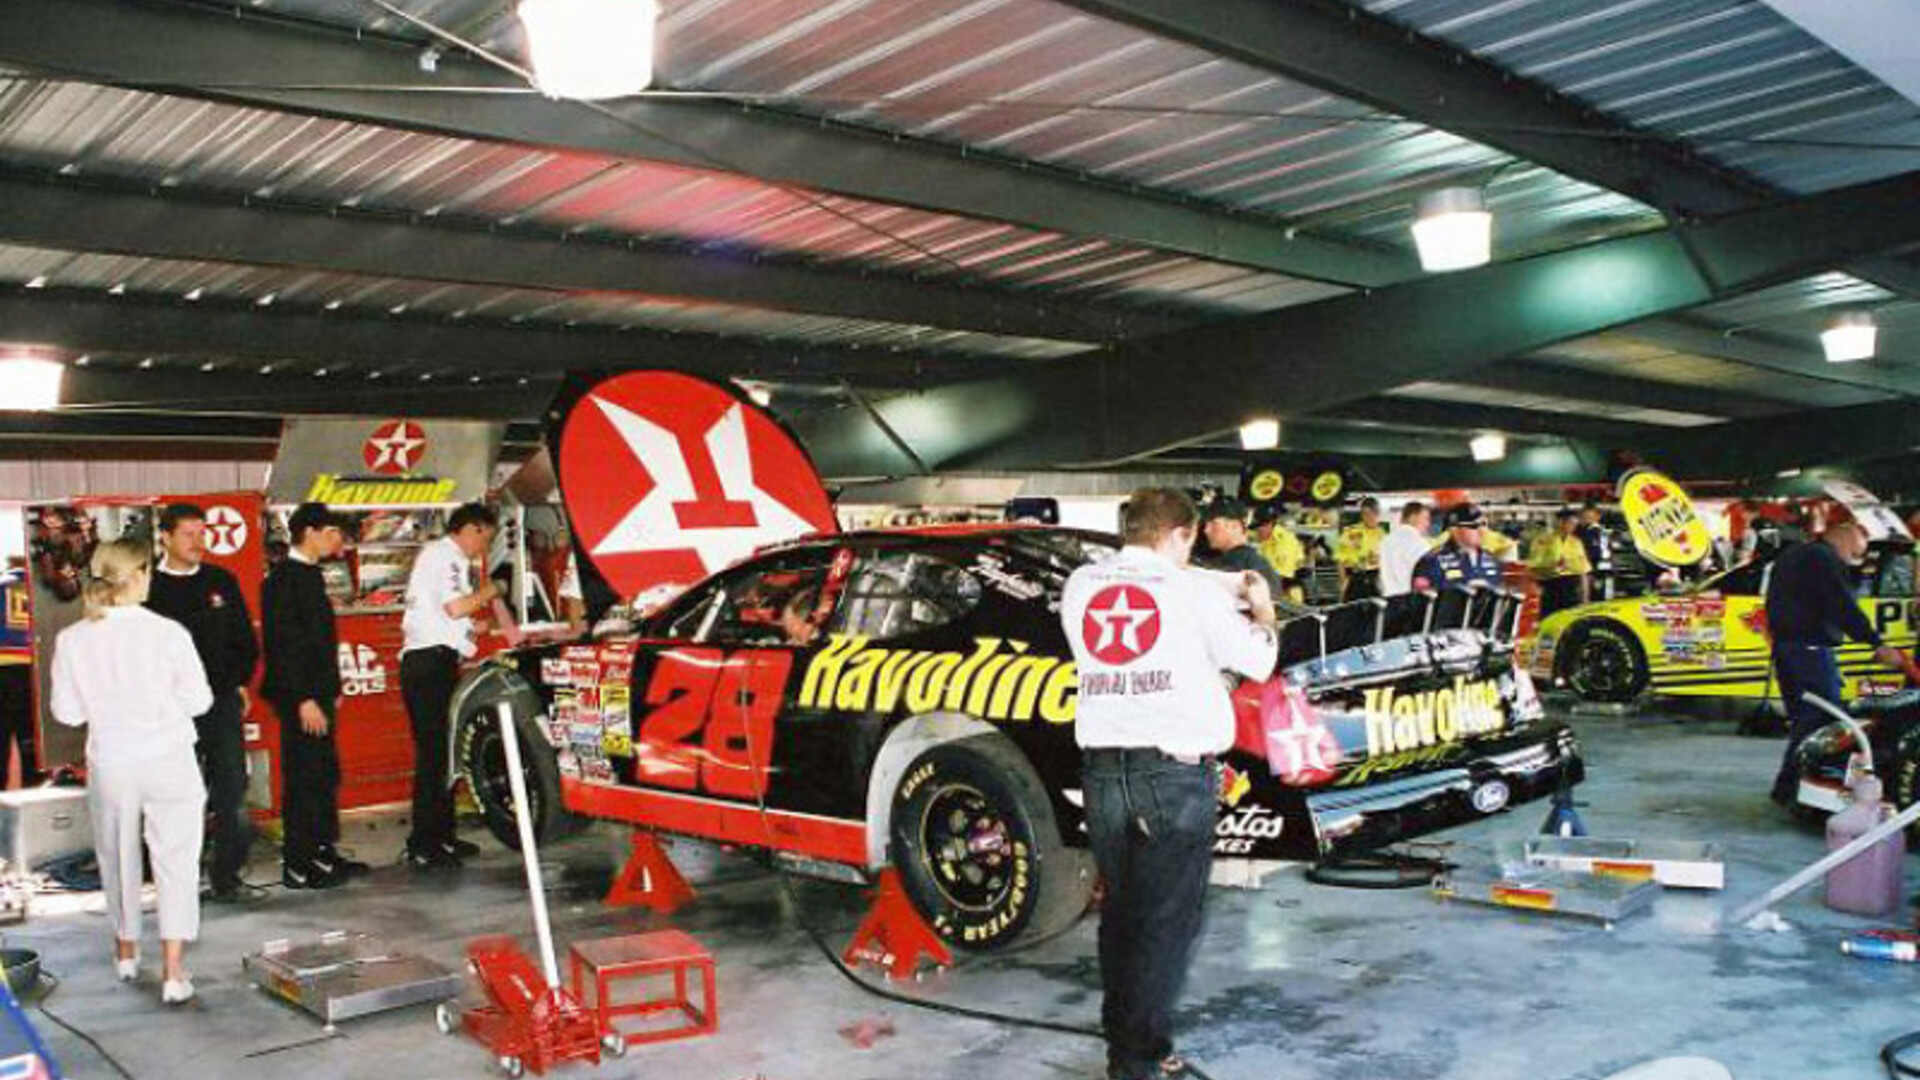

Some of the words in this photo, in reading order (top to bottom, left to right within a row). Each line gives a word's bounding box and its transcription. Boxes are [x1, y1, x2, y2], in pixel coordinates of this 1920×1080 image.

[338, 642, 386, 680] AC
[799, 634, 1077, 722] Havoline
[637, 647, 793, 796] 28
[1363, 676, 1506, 757] Havoline
[1213, 838, 1256, 854] KES
[1215, 804, 1284, 840] stos
